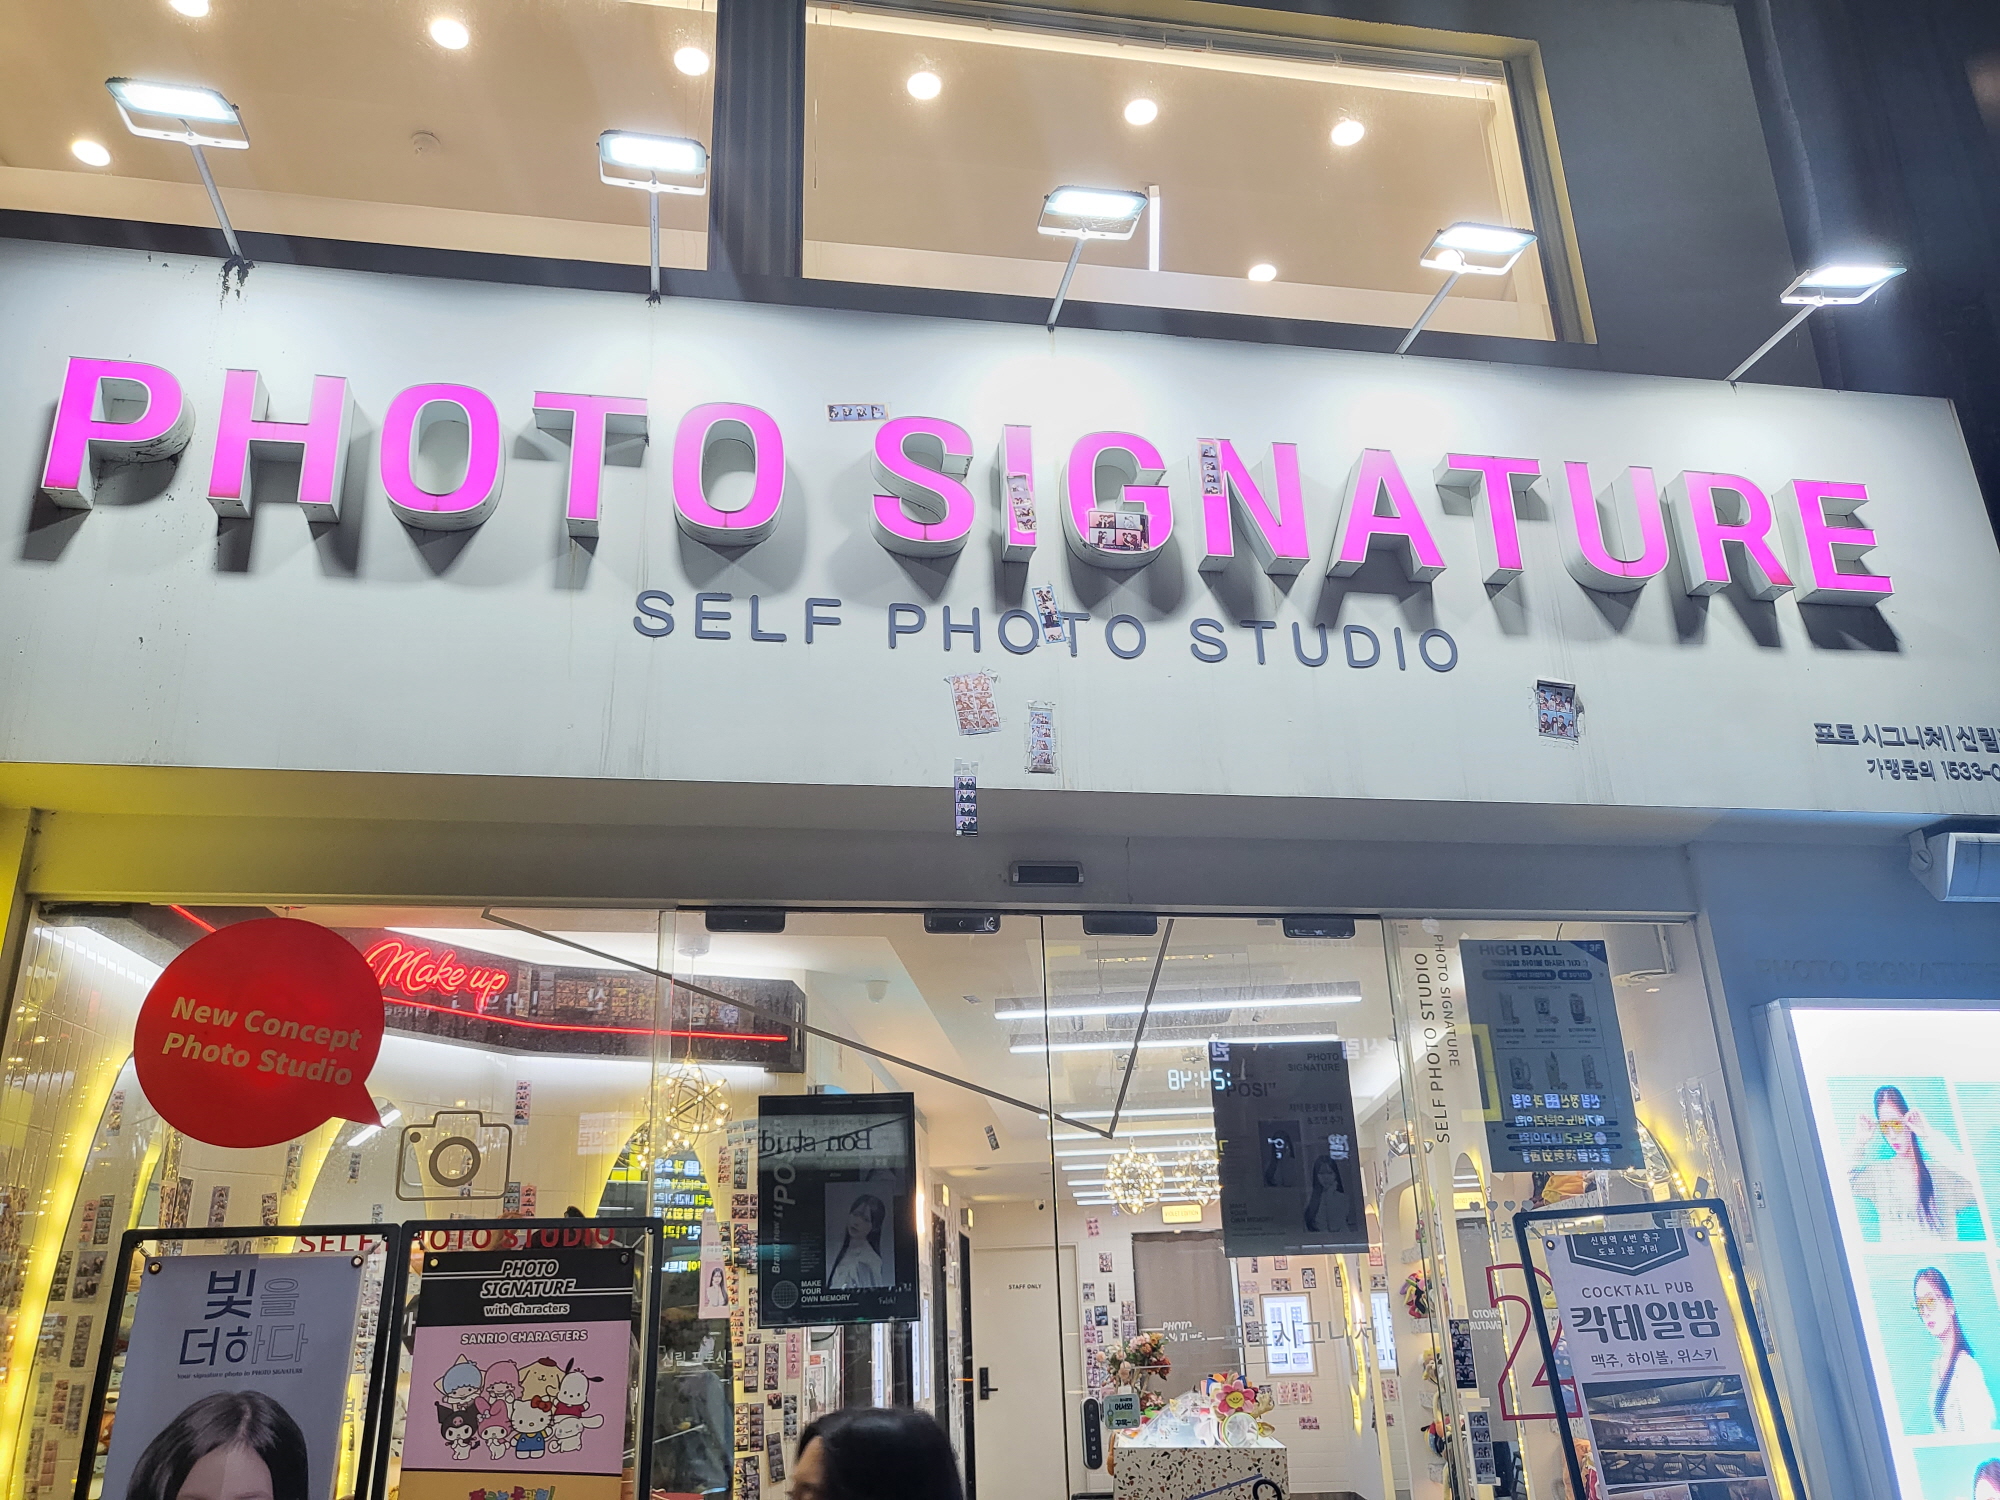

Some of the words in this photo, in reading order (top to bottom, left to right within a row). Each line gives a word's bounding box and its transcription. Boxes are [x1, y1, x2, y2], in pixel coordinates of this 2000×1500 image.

[41, 357, 787, 538] PHOTO
[872, 416, 1894, 596] SIGNATURE
[633, 589, 842, 645] SELF
[887, 602, 1147, 660] PHOTO
[1189, 617, 1459, 673] STUDIO
[1813, 722, 1859, 746] 포토
[1956, 725, 2000, 754] 신림
[1866, 758, 1937, 782] 가맹문의
[1434, 934, 1449, 982] PHOTO
[1479, 944, 1518, 956] HIGH
[1520, 944, 1563, 956] BALL
[365, 940, 467, 993] Make
[470, 967, 511, 1005] up
[1414, 953, 1435, 1021] STUDIO
[171, 996, 238, 1028] New
[244, 1009, 363, 1052] Concept
[1440, 987, 1461, 1067] SIGNATURE
[161, 1032, 251, 1068] Photo
[256, 1049, 353, 1086] Studio
[1287, 1063, 1341, 1072] SIGNATURE
[1306, 1052, 1339, 1061] PHOTO
[1424, 1027, 1444, 1091] PHOTO
[1432, 1098, 1451, 1144] SELF
[1590, 1234, 1618, 1246] 신림역
[1622, 1233, 1638, 1244] 4번
[1642, 1232, 1660, 1242] 출구
[1598, 1247, 1616, 1256] 도보
[1621, 1246, 1635, 1255] 1분
[1640, 1244, 1659, 1255] 거리
[502, 1259, 559, 1279] PHOTO
[204, 1268, 300, 1321] 빛을
[480, 1279, 576, 1299] SIGNATURE
[801, 1279, 822, 1288] MAKE
[801, 1287, 822, 1295] YOUR
[1581, 1283, 1660, 1299] COCKTAIL
[1664, 1281, 1694, 1294] PUB
[484, 1303, 510, 1317] with
[511, 1302, 570, 1316] Characters
[801, 1295, 819, 1303] OWN
[819, 1293, 851, 1302] MEMORY
[1570, 1298, 1722, 1345] 칵테일밤
[178, 1322, 309, 1367] 더하다
[460, 1332, 508, 1345] SANRIO
[509, 1329, 588, 1344] CHARACTERS
[1591, 1352, 1624, 1369] 맥주,
[1626, 1350, 1674, 1367] 하이볼,
[1677, 1347, 1719, 1364] 위스키
[224, 1371, 243, 1379] photo
